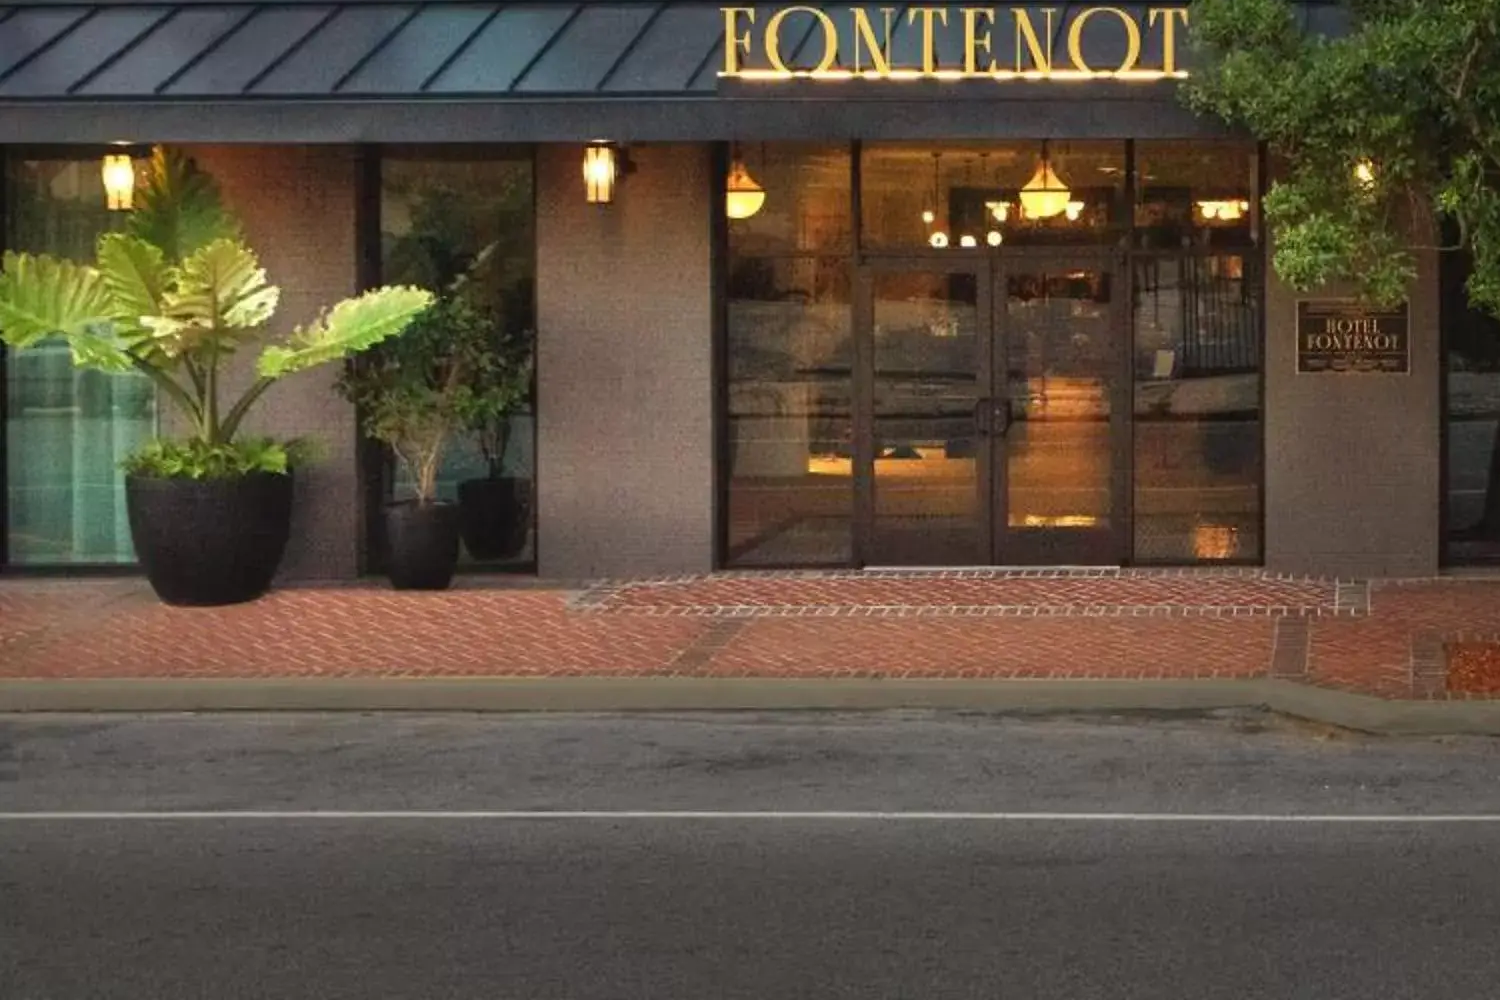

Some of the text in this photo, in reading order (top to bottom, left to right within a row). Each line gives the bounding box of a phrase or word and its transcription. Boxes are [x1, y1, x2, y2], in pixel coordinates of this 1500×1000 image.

[720, 6, 1189, 75] FONTENOT
[1326, 319, 1379, 333] HOTEL
[1307, 333, 1398, 350] FONTENOT
